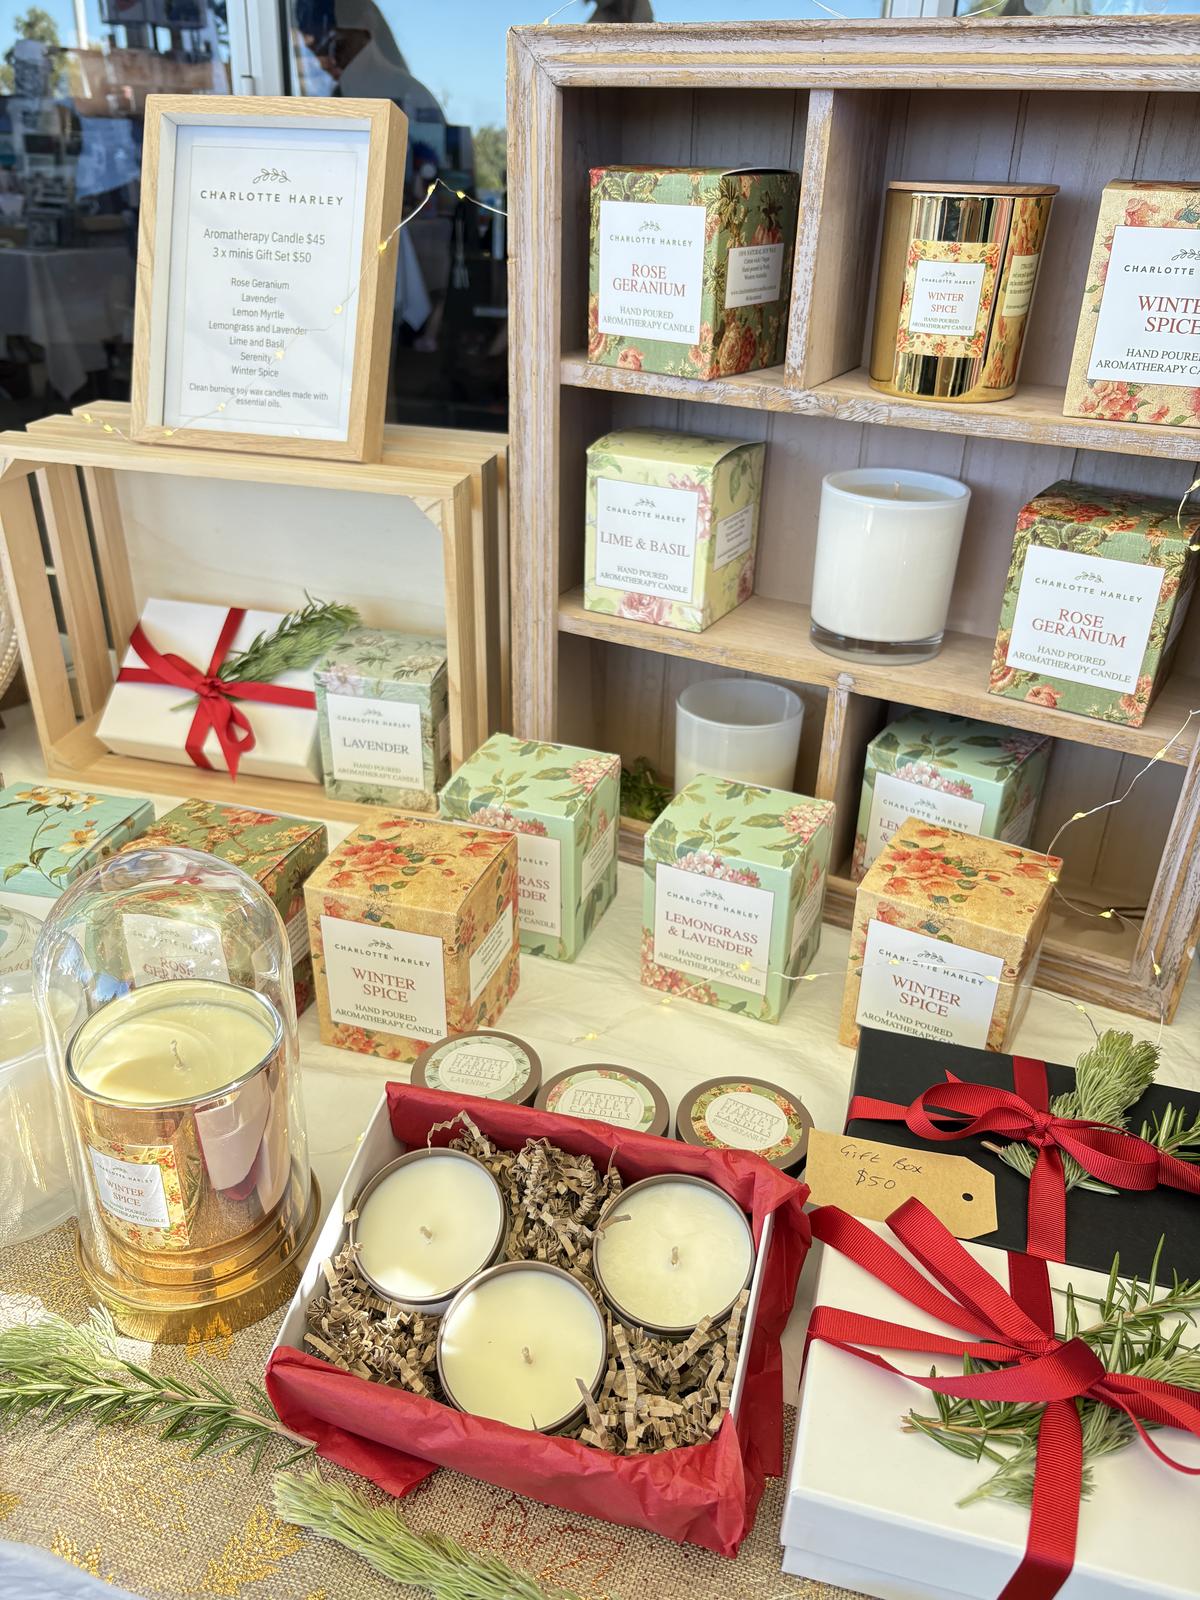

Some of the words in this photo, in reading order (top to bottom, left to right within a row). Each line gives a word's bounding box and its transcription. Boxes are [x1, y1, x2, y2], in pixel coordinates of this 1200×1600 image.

[200, 190, 280, 202] CHARLOTTE
[289, 194, 344, 206] HARLEY
[204, 228, 270, 244] Aromatherapy
[272, 232, 304, 244] Candle
[306, 234, 326, 246] $45
[610, 234, 656, 244] CHARLOTTE
[660, 238, 693, 248] HARLEY
[213, 247, 219, 258] 3
[228, 248, 254, 260] minis
[256, 250, 272, 262] Gift
[274, 250, 290, 262] Set
[292, 252, 312, 264] $50
[632, 264, 667, 280] ROSE
[1124, 264, 1196, 276] CHARLOTTE
[231, 278, 250, 288] Rose
[252, 278, 290, 290] Geranium
[612, 278, 686, 297] GERANIUM
[241, 293, 277, 304] Lavender
[928, 292, 964, 302] WINTER
[1138, 295, 1200, 314] WINTE
[232, 308, 258, 318] Lemon
[260, 310, 285, 322] Myrtle
[620, 306, 642, 316] HAND
[643, 308, 674, 320] POURED
[930, 304, 957, 314] SPICE
[208, 321, 254, 334] Lemongrass
[256, 323, 270, 333] and
[272, 324, 308, 336] Lavender
[602, 315, 662, 330] AROMATHERAPY
[662, 324, 695, 334] CANDLE
[912, 322, 950, 330] AROMATHERAPY
[1144, 316, 1200, 336] SPICE
[229, 336, 248, 346] Lime
[250, 338, 264, 348] and
[266, 338, 285, 349] Basil
[240, 352, 272, 364] Serenity
[1126, 348, 1158, 359] HAND
[1161, 350, 1200, 362] POURE
[231, 366, 256, 376] Winter
[258, 367, 279, 378] Spice
[1096, 360, 1187, 374] AROMATHERAPY
[189, 382, 208, 392] Clean
[210, 384, 235, 396] burning
[236, 388, 248, 397] soy
[250, 388, 264, 396] wax
[264, 388, 291, 399] candles
[292, 390, 312, 400] made
[313, 390, 328, 400] with
[236, 397, 266, 407] essential
[268, 400, 282, 408] oils.
[606, 506, 651, 518] CHARLOTTE
[655, 511, 686, 524] HARLEY
[600, 532, 633, 548] LIME
[636, 538, 646, 550] &
[650, 540, 690, 558] BASIL
[617, 566, 638, 576] HAND
[639, 569, 668, 581] POURED
[600, 572, 658, 589] AROMATHERAPY
[658, 582, 688, 594] CANDLE
[1034, 577, 1095, 595] CHARLOTTE
[1100, 590, 1144, 604] HARLEY
[1059, 608, 1104, 628] ROSE
[1032, 618, 1127, 648] GERANIUM
[1038, 645, 1065, 660] HAND
[1066, 652, 1106, 667] POURED
[1012, 650, 1090, 674] AROMATHERAPY
[1090, 668, 1132, 684] CANDLE
[337, 715, 380, 726] CHARLOTTE
[382, 720, 410, 728] HARLEY
[343, 738, 410, 754] LAVENDER
[338, 768, 392, 780] AROMATHERAPY
[392, 774, 420, 784] CANDLE
[374, 764, 401, 773] POURED
[883, 799, 931, 818] CHARLOTTE
[935, 816, 968, 830] HARLEY
[667, 890, 719, 910] CHARLOTTE
[724, 906, 760, 920] HARLEY
[524, 917, 556, 929] CANDLE
[665, 911, 758, 944] LEMONGRASS
[668, 925, 678, 937] &
[681, 927, 753, 957] LAVENDER
[334, 944, 388, 960] CHARLOTTE
[394, 956, 430, 967] HARLEY
[678, 949, 703, 962] HAND
[704, 956, 738, 971] POURED
[161, 958, 196, 977] ROSE
[658, 952, 724, 976] AROMATHERAPY
[725, 971, 760, 986] CANDLE
[352, 966, 416, 991] WINTER
[943, 970, 984, 986] HARLEY
[364, 984, 408, 1002] SPICE
[892, 974, 960, 1007] WINTER
[355, 1004, 380, 1015] HAND
[382, 1010, 417, 1022] POURED
[900, 992, 948, 1018] SPICE
[336, 1008, 405, 1028] AROMATHERAPY
[406, 1023, 442, 1036] CANDLE
[862, 1012, 938, 1041] AROMATHERAPY
[886, 1010, 914, 1024] HAND
[915, 1020, 953, 1038] POURED
[572, 1093, 632, 1112] HARLEY
[569, 1106, 632, 1118] CANDLES
[840, 1144, 882, 1163] Gift
[893, 1157, 922, 1174] Box
[856, 1167, 896, 1190] $50
[106, 1179, 144, 1197] WINTER
[112, 1192, 141, 1207] SPICE
